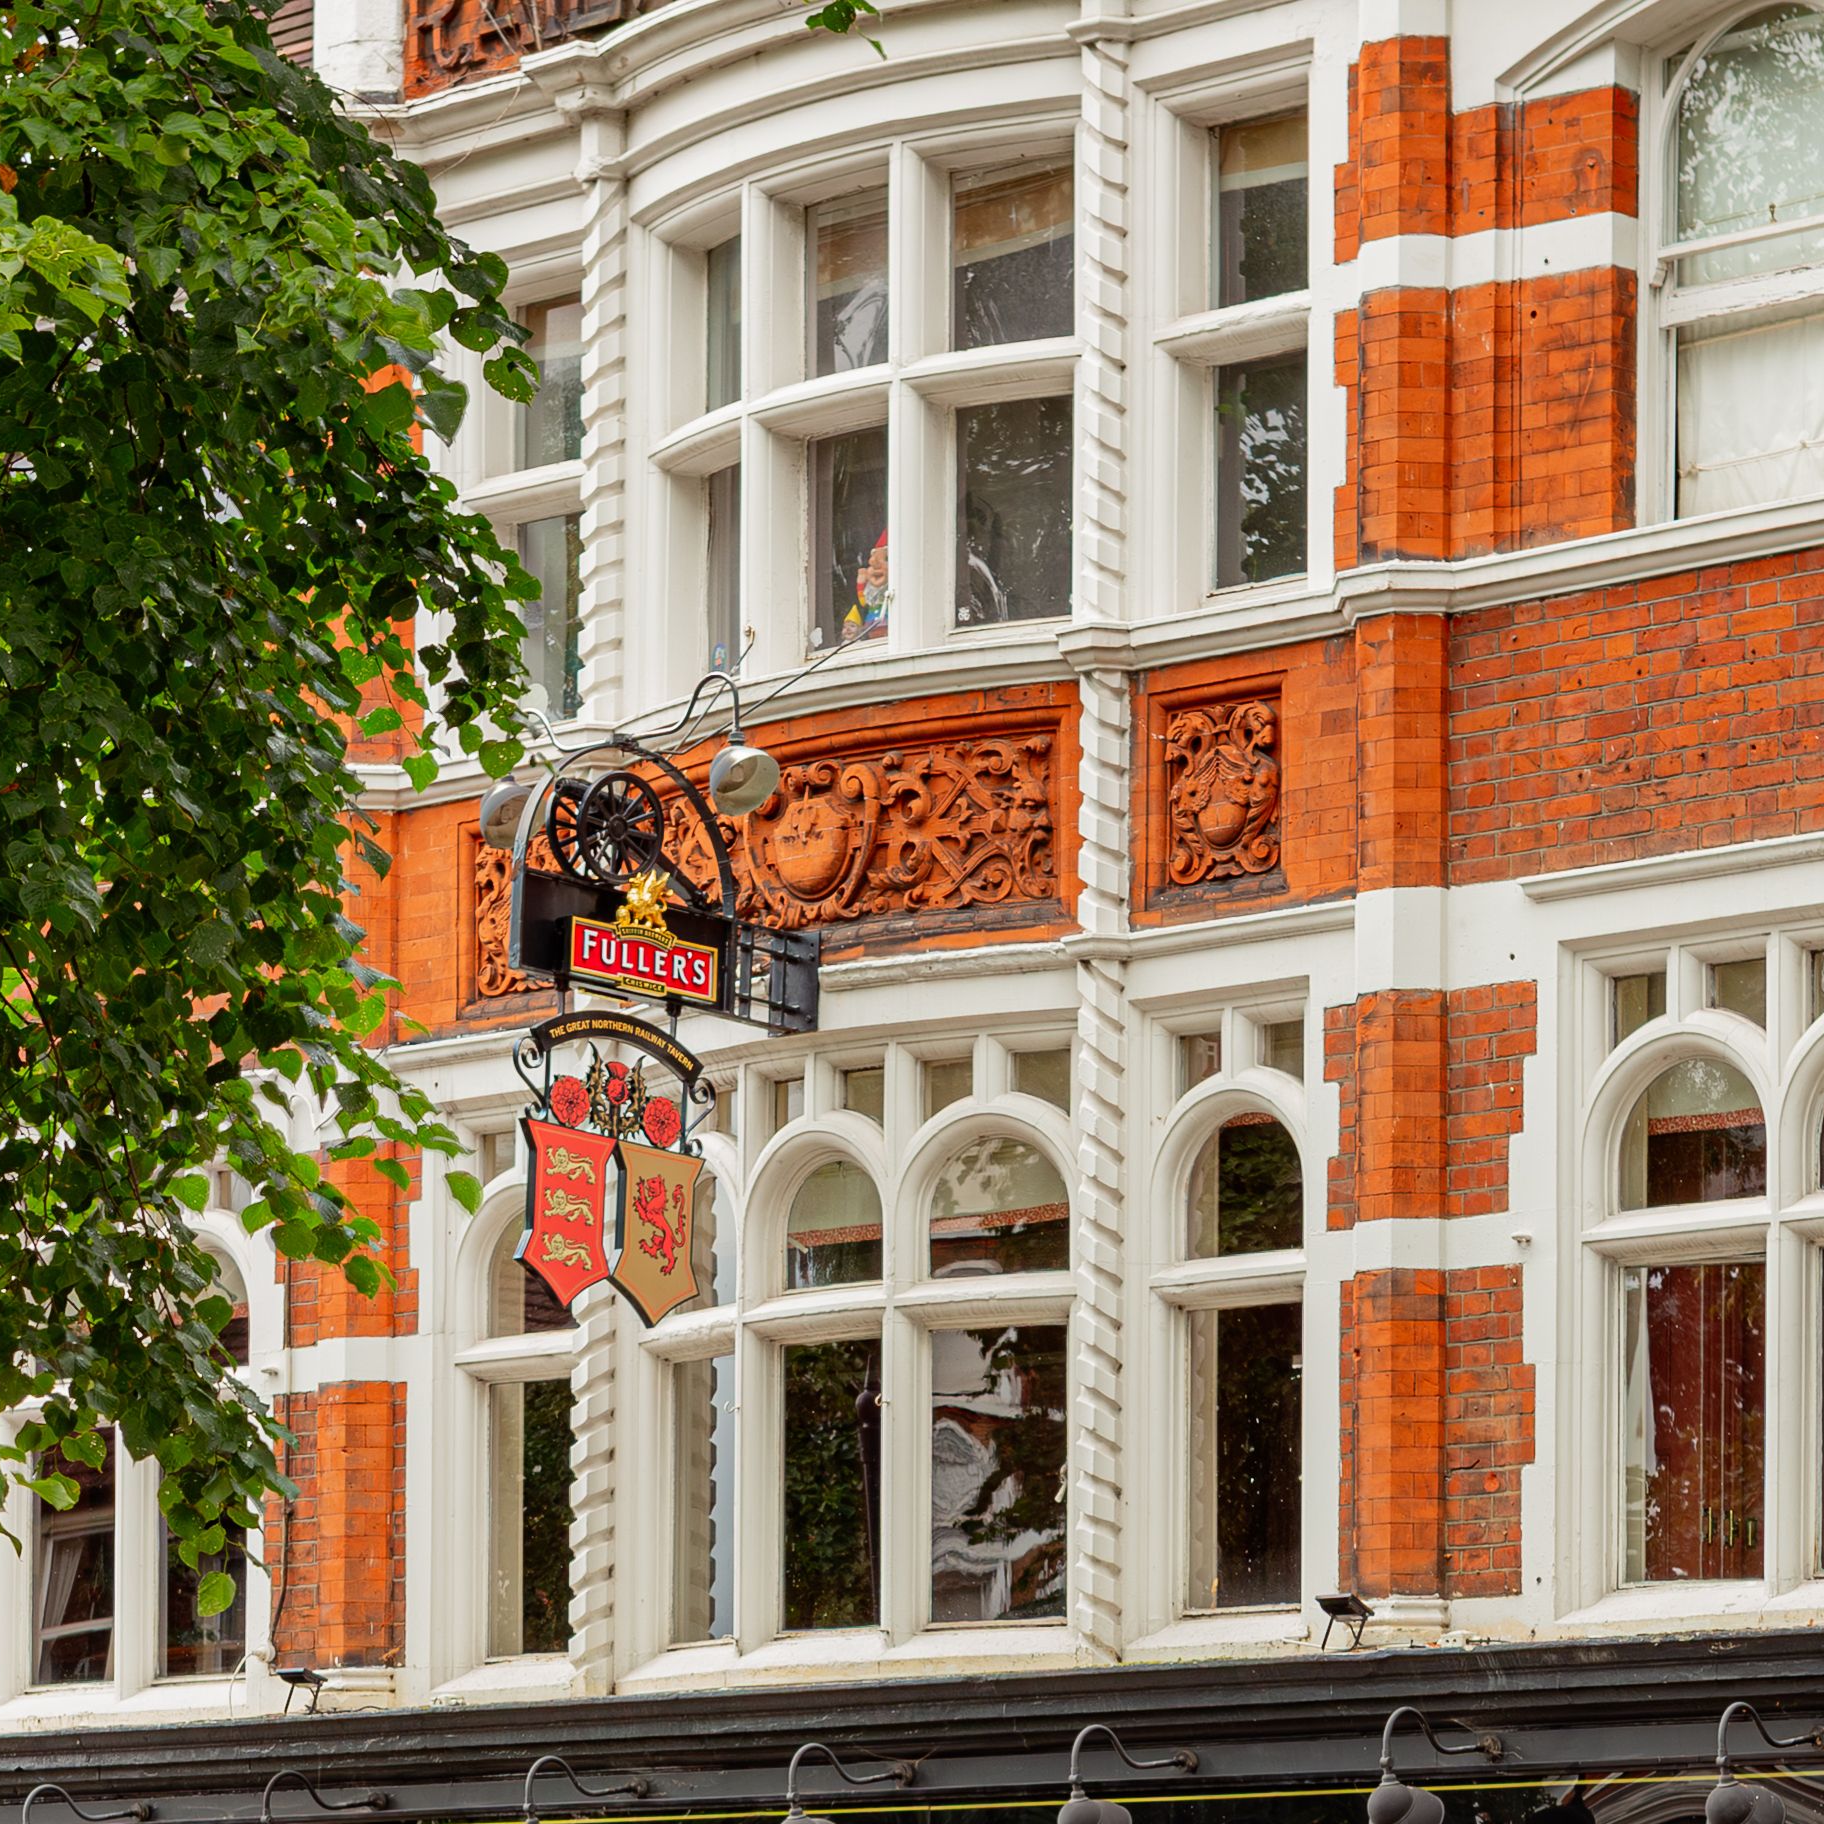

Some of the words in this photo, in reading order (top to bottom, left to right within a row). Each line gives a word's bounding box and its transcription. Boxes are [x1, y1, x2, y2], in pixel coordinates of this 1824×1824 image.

[582, 928, 706, 986] FULLER'S
[549, 1026, 566, 1039] THE
[566, 1019, 590, 1033] GREAT
[591, 1019, 633, 1034] NORTHERN
[635, 1027, 667, 1049] RAILWAY
[666, 1043, 694, 1072] TAVERN
